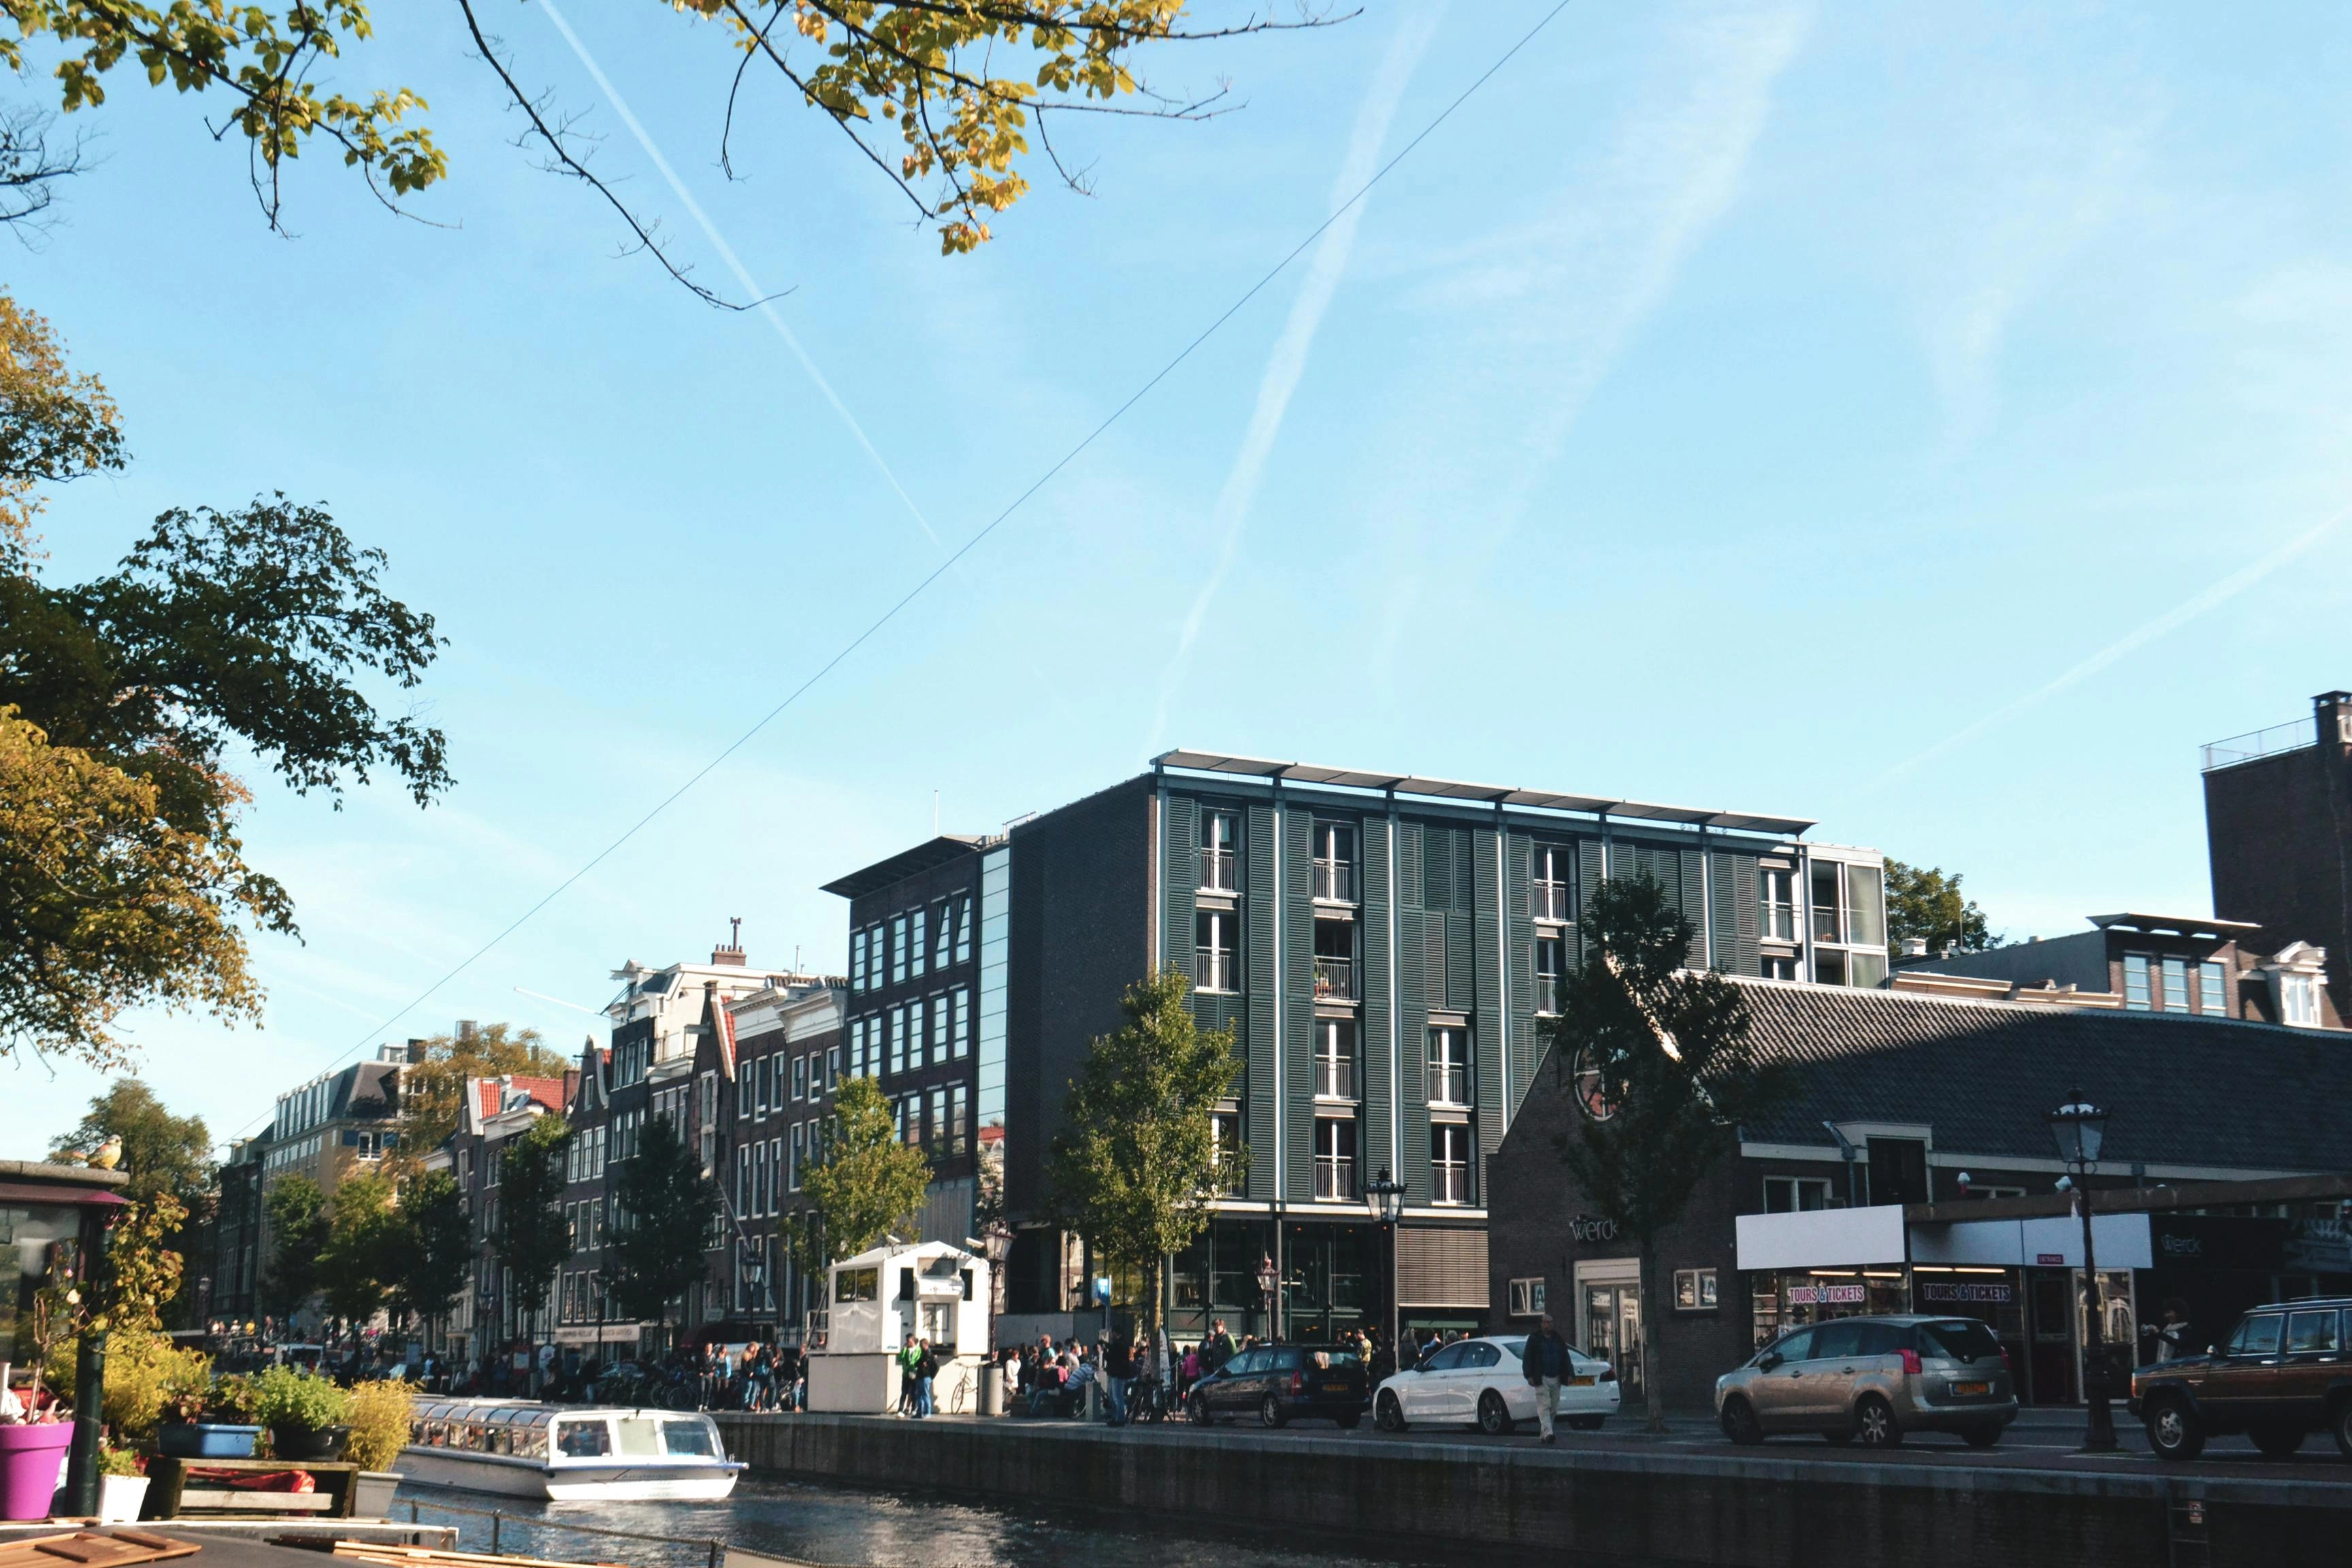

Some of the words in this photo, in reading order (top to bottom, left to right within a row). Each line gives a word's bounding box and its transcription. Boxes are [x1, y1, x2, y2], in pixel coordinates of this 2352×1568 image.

[2038, 1255, 2062, 1263] ENTRANCE
[1788, 1287, 1818, 1303] TOURS
[1818, 1286, 1827, 1303] &
[1827, 1285, 1864, 1302] TICKETS
[1923, 1284, 1958, 1301] TOURS
[1959, 1284, 1968, 1301] &
[1968, 1285, 2010, 1301] TICKETS
